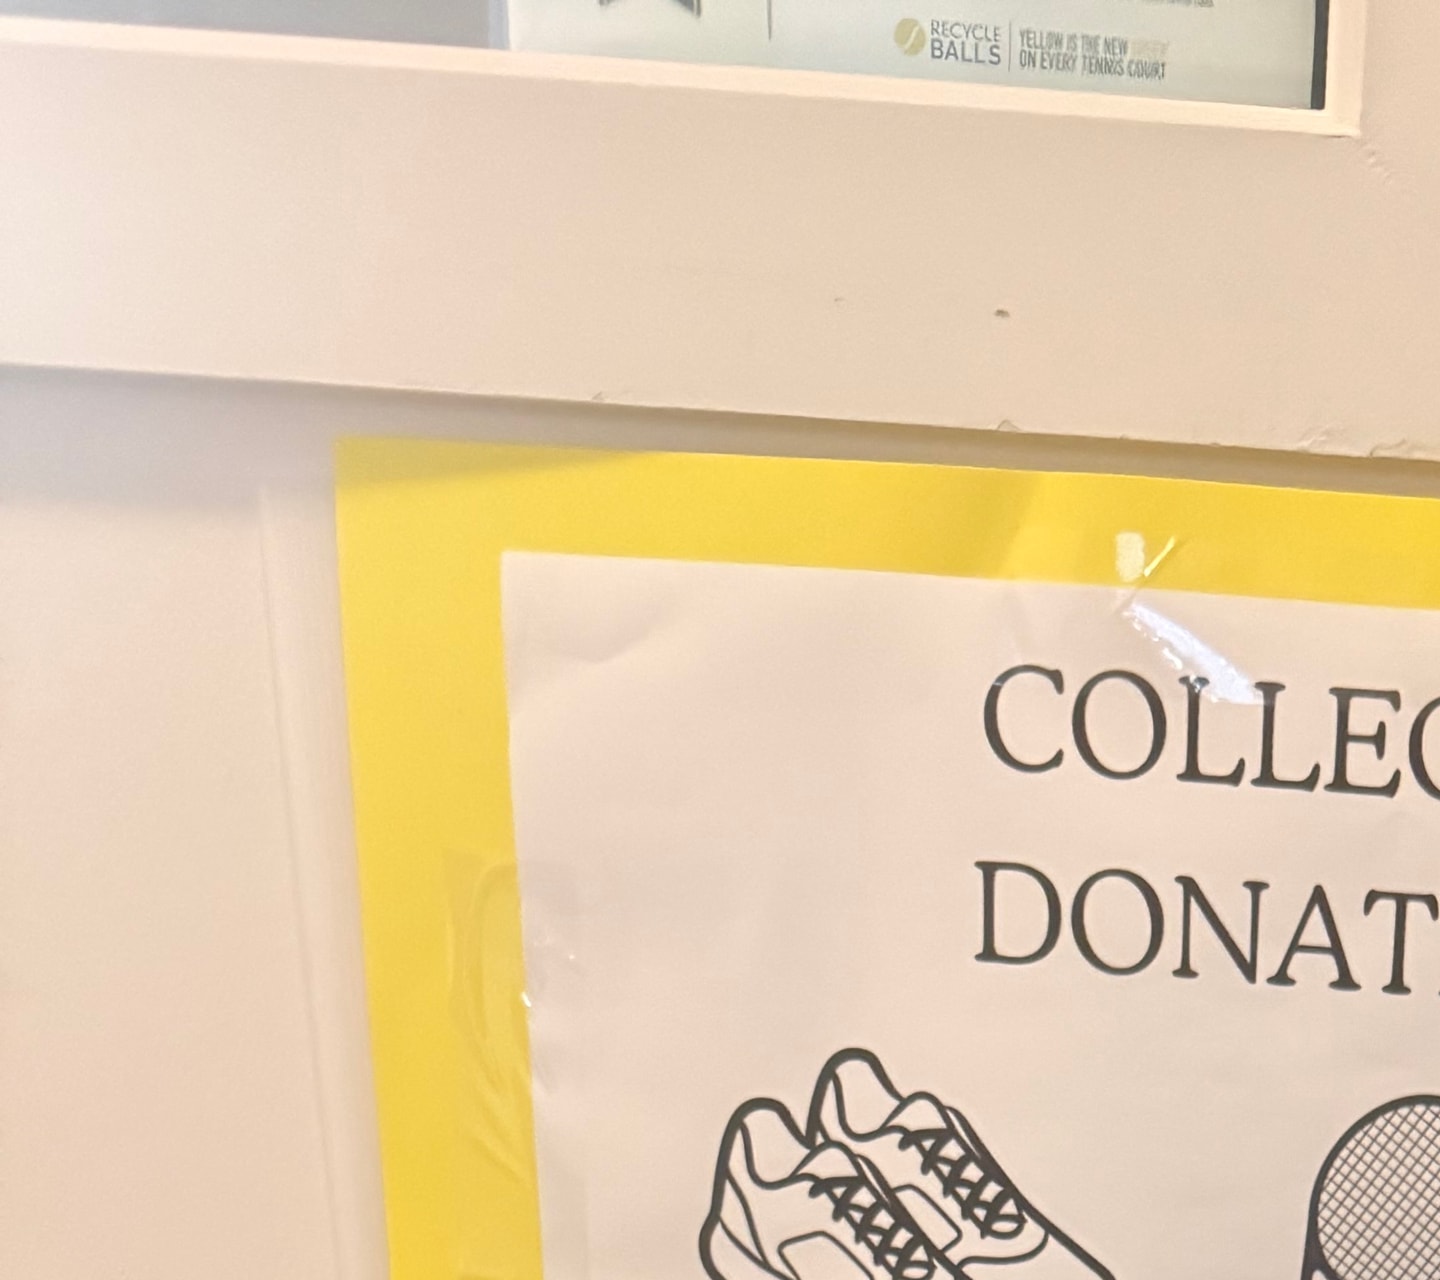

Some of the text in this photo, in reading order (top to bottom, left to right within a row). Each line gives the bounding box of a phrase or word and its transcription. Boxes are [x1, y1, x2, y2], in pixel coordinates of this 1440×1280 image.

[930, 19, 1001, 43] RECYCLE
[1019, 28, 1064, 50] YELLOW
[1103, 36, 1128, 57] NEW
[930, 38, 1001, 66] BALLS
[1019, 48, 1036, 69] ON
[1040, 51, 1078, 73] EVERY
[1082, 54, 1124, 77] TENNIS
